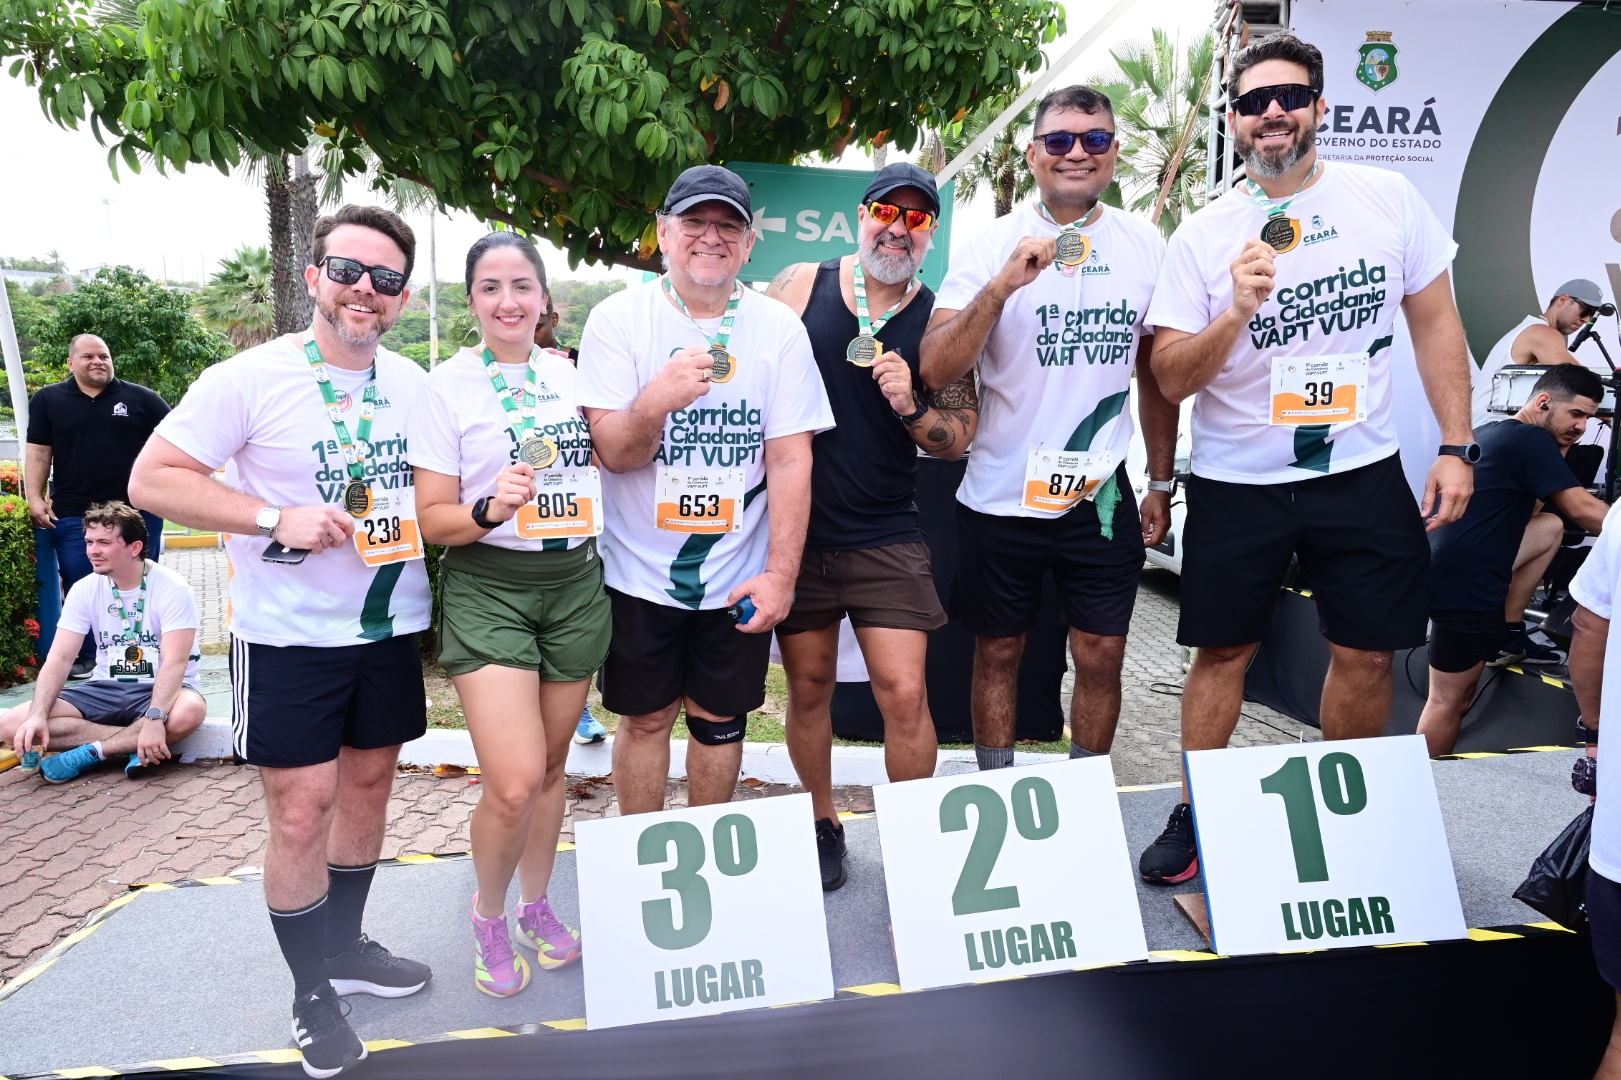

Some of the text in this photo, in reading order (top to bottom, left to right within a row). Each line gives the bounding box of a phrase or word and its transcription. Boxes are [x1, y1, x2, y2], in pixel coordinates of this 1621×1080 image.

[1315, 137, 1442, 149] OVERNO DO ESTADO
[1366, 154, 1405, 163] PROTEÇÃO
[1303, 226, 1338, 243] CEARÁ
[1081, 264, 1110, 273] CEARÁ
[1277, 258, 1386, 305] corrida
[1036, 299, 1137, 327] 1ª corrida
[1249, 286, 1386, 332] da Cidadania
[1036, 328, 1059, 345] da
[1251, 303, 1384, 350] VAPT VUPT
[1036, 344, 1131, 367] VAPT VUPT
[373, 397, 391, 406] ARÁ
[537, 393, 561, 401] CEARÁ
[1304, 381, 1334, 407] 39
[671, 399, 761, 426] corrida
[670, 426, 761, 445] Cidadania
[312, 440, 338, 463] 1ª
[653, 444, 761, 467] APT VUPT
[315, 464, 344, 482] da
[1048, 473, 1087, 497] 874
[537, 492, 578, 519] 805
[679, 494, 720, 517] 653
[364, 515, 401, 545] 238
[1260, 752, 1367, 883] 1º
[939, 777, 1059, 916] 2º
[637, 813, 759, 950] 3º
[1281, 896, 1395, 941] LUGAR
[964, 921, 1077, 971] LUGAR
[654, 959, 766, 1010] LUGAR
